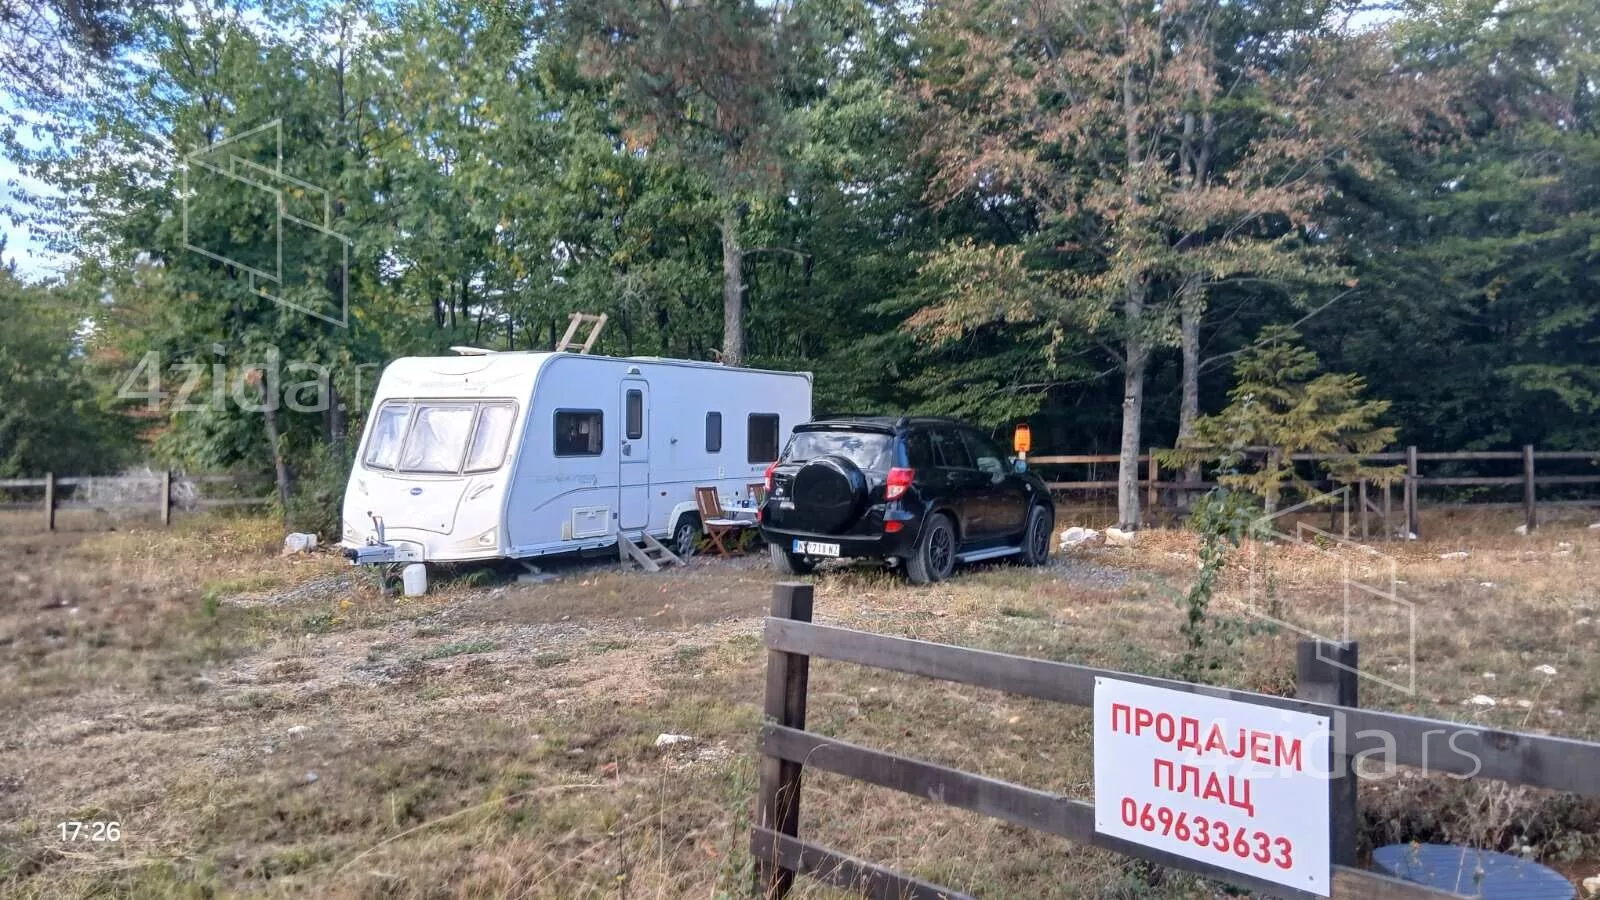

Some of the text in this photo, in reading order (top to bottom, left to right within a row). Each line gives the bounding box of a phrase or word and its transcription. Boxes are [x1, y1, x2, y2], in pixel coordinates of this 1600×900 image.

[1111, 702, 1303, 772] ПРОДАЈЕМ
[1153, 758, 1255, 818] ПЛАЦ
[1120, 796, 1294, 870] 069633633
